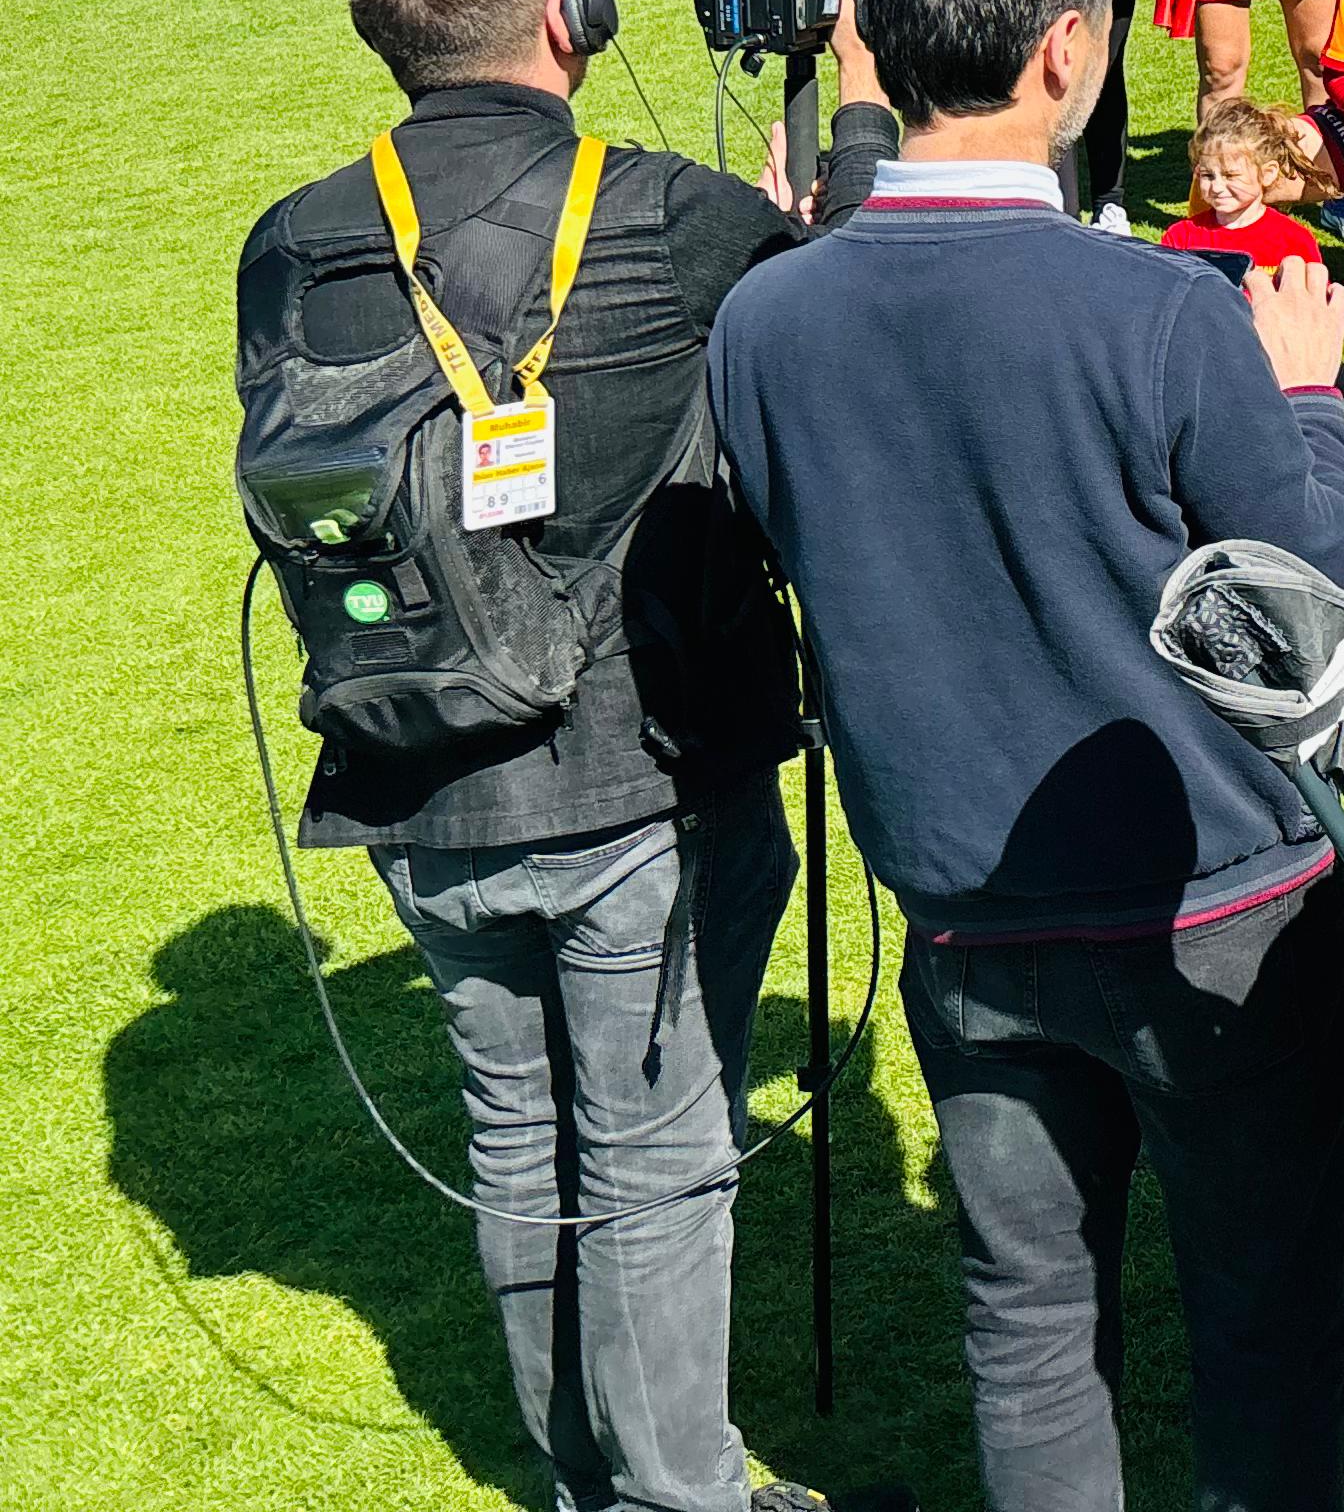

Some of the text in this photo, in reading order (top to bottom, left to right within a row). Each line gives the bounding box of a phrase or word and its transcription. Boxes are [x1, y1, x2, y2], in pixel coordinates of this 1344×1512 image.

[440, 341, 467, 374] TFF
[489, 418, 531, 432] Muhabir
[538, 473, 547, 485] 6
[487, 493, 509, 508] 8 9
[349, 594, 385, 608] TVU
